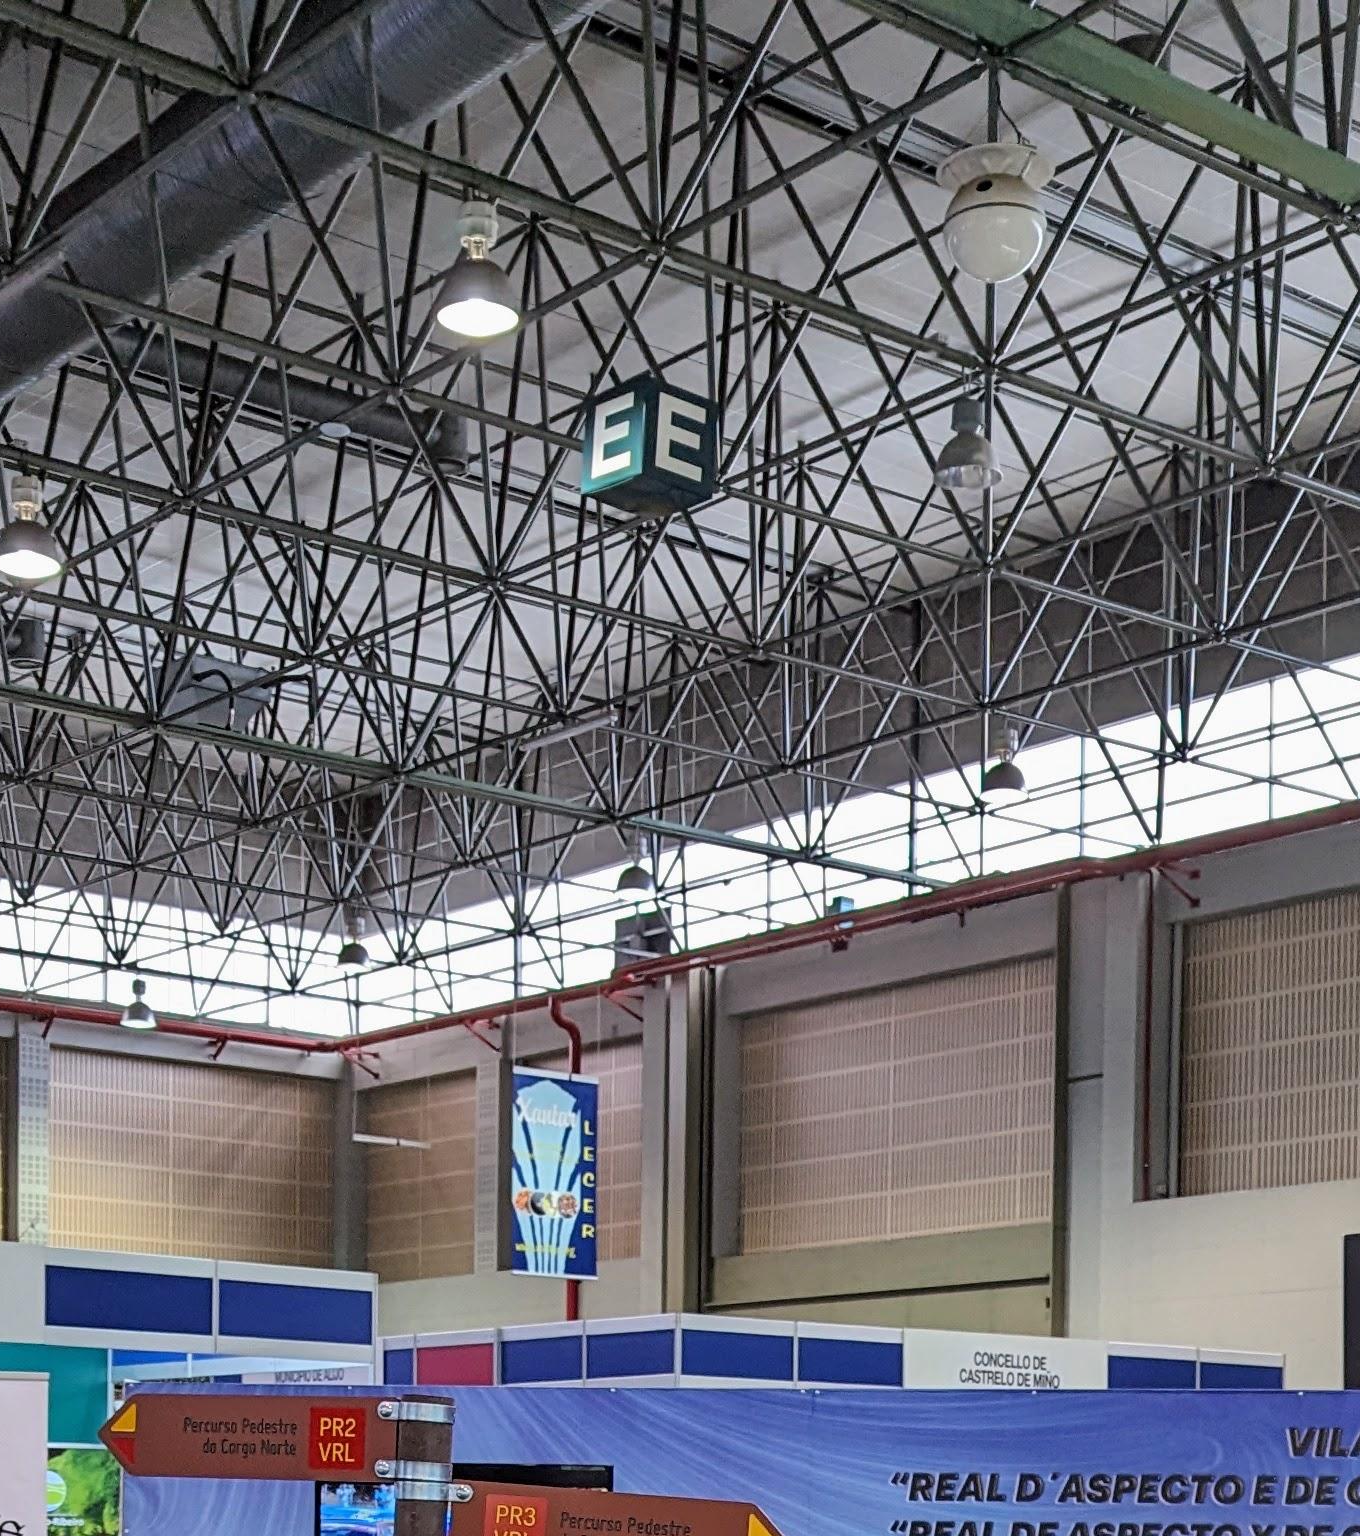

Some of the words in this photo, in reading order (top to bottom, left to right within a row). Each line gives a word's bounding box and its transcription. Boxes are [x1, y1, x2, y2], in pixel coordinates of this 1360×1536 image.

[591, 392, 634, 479] E
[655, 392, 706, 482] E
[974, 1352, 1030, 1369] CONCELLO
[1033, 1357, 1046, 1370] DE
[960, 1369, 1014, 1386] CASTRELO
[1017, 1373, 1030, 1387] DE
[1033, 1371, 1060, 1388] MIÑO
[183, 1416, 237, 1433] Percurso
[242, 1418, 297, 1435] Pedestre
[319, 1418, 356, 1437] PR2
[222, 1439, 256, 1459] Corgo
[261, 1440, 296, 1455] Norte
[318, 1443, 355, 1462] VRL
[1253, 1474, 1278, 1504] E
[1285, 1476, 1339, 1506] DE
[496, 1505, 536, 1527] PR3
[560, 1512, 622, 1532] Percurso
[628, 1517, 690, 1536] Pedestre
